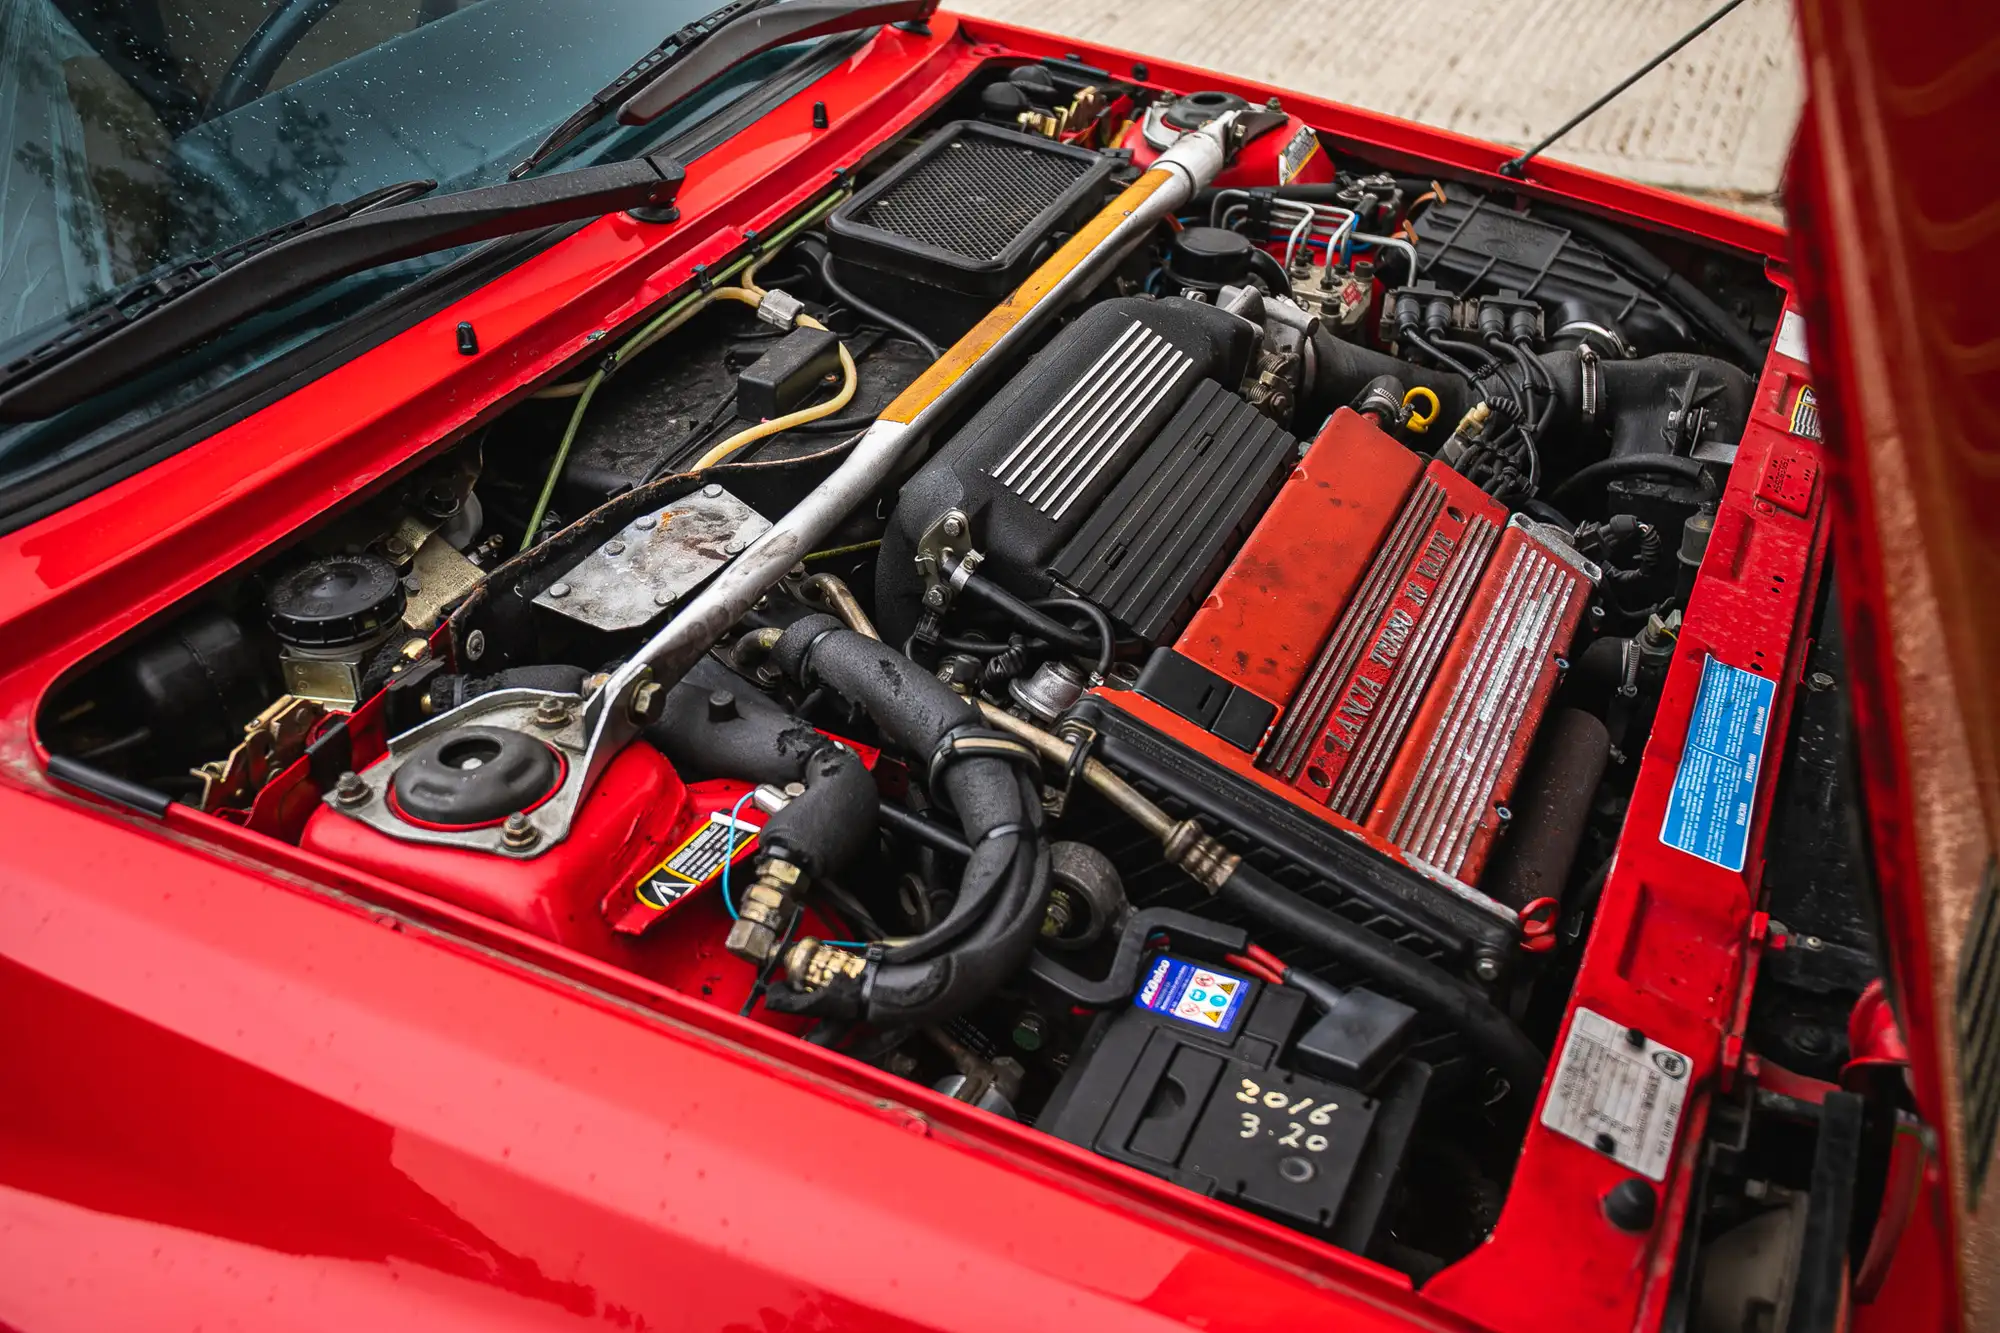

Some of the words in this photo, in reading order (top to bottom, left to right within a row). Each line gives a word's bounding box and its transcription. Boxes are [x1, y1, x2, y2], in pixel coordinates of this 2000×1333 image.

[1416, 530, 1454, 581] VALVE
[1405, 581, 1428, 606] 16
[1369, 608, 1413, 669] TURBO
[1326, 675, 1383, 752] LANCIA
[1753, 705, 1765, 736] IMPORTANTE
[1745, 752, 1757, 783] IMPORTANT
[1735, 802, 1747, 826] WICHTIG
